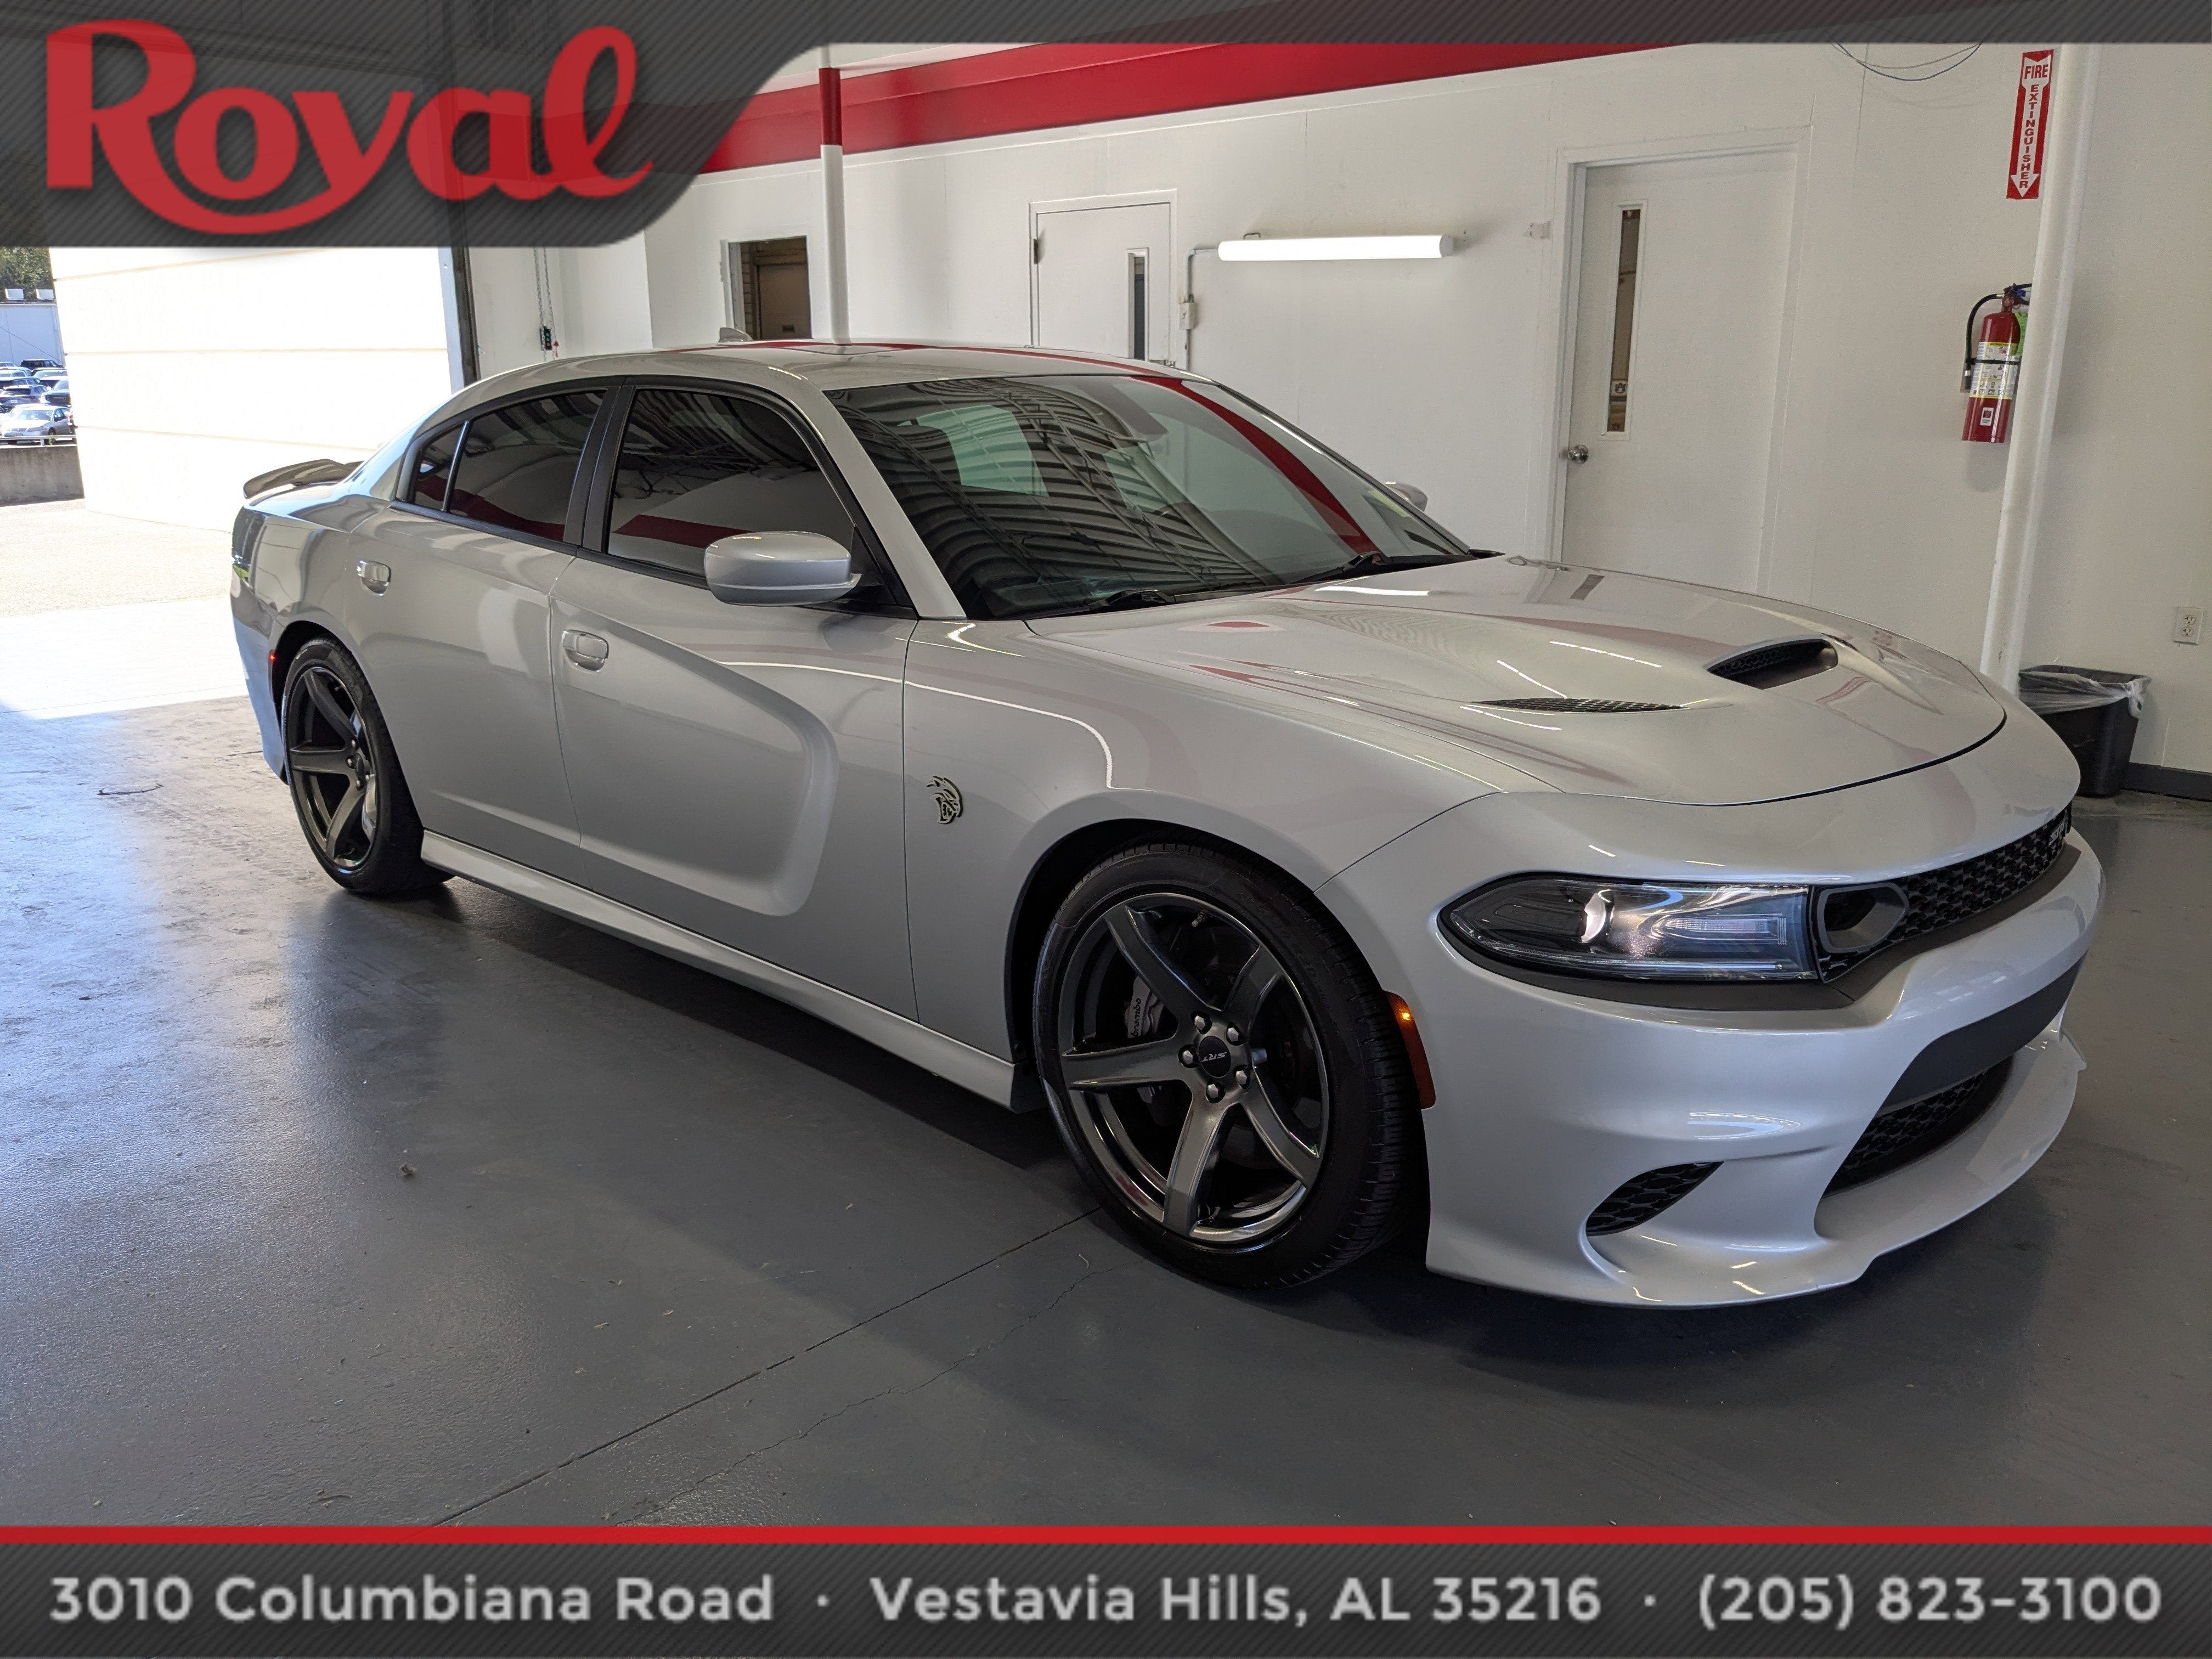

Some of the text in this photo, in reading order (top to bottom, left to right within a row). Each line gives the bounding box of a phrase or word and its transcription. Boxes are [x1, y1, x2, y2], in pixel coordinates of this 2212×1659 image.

[2024, 64, 2049, 80] FIRE
[2019, 83, 2040, 189] EXTINGUISHER
[1131, 997, 1142, 1036] brembo
[1201, 1052, 1227, 1062] SRT
